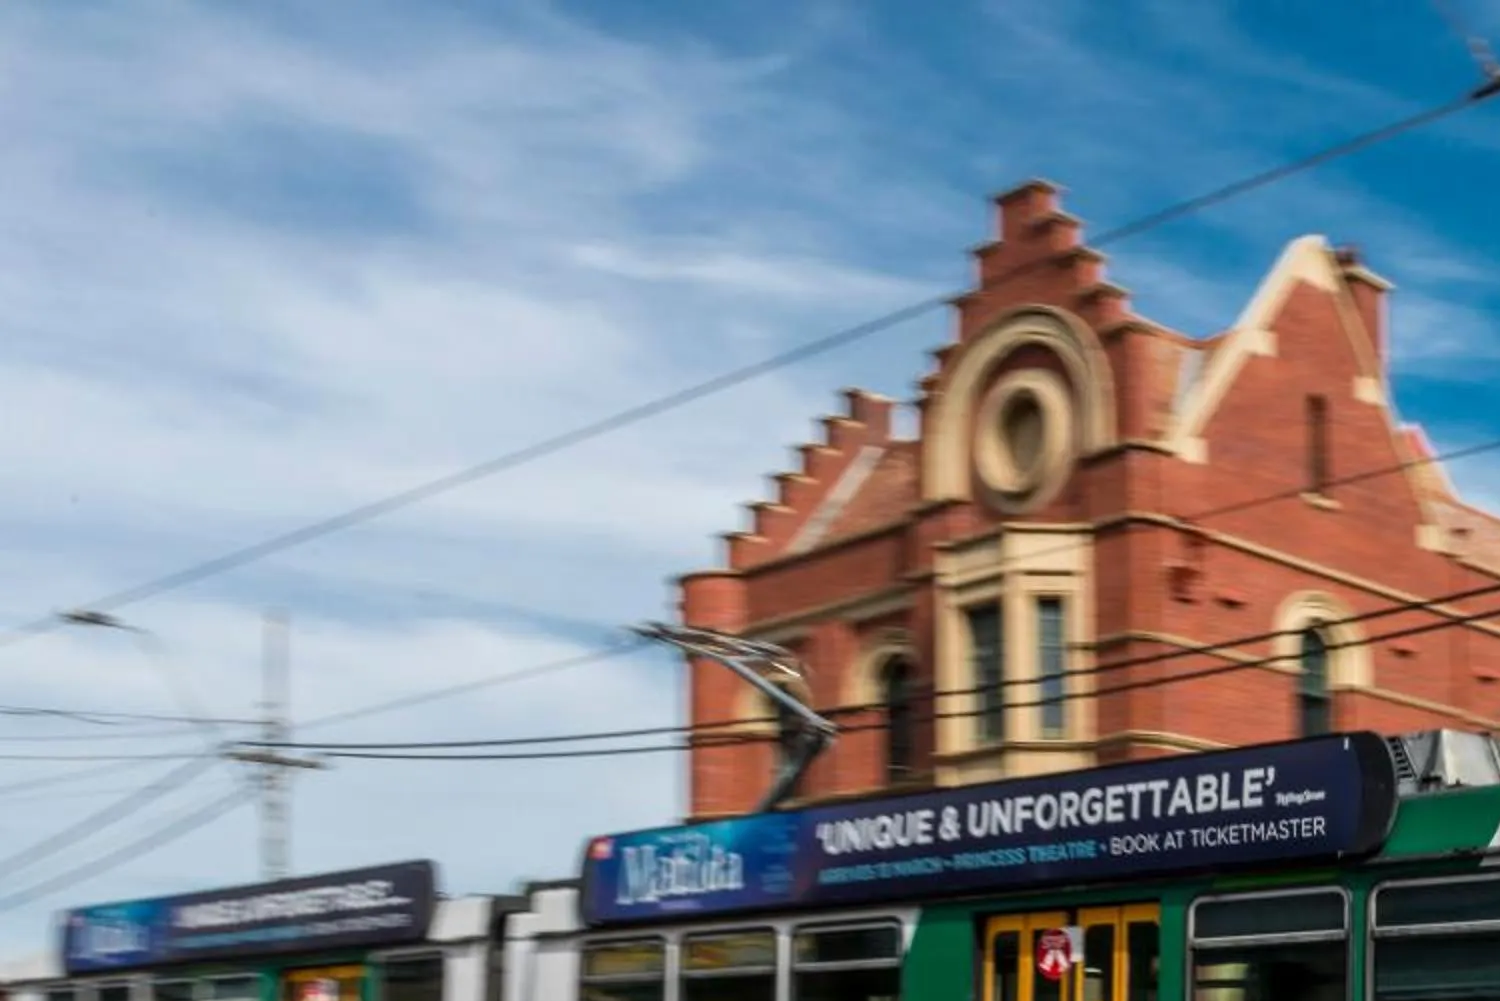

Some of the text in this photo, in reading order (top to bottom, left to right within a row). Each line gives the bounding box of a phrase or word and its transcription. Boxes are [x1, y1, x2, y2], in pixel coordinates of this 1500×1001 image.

[816, 766, 1276, 854] 'UNIQUE & UNFORGETTABLE'
[1027, 840, 1096, 863] THEATRE
[1109, 833, 1160, 856] BOOK
[1163, 829, 1186, 850] AT
[1190, 815, 1327, 848] TICKETMASTER
